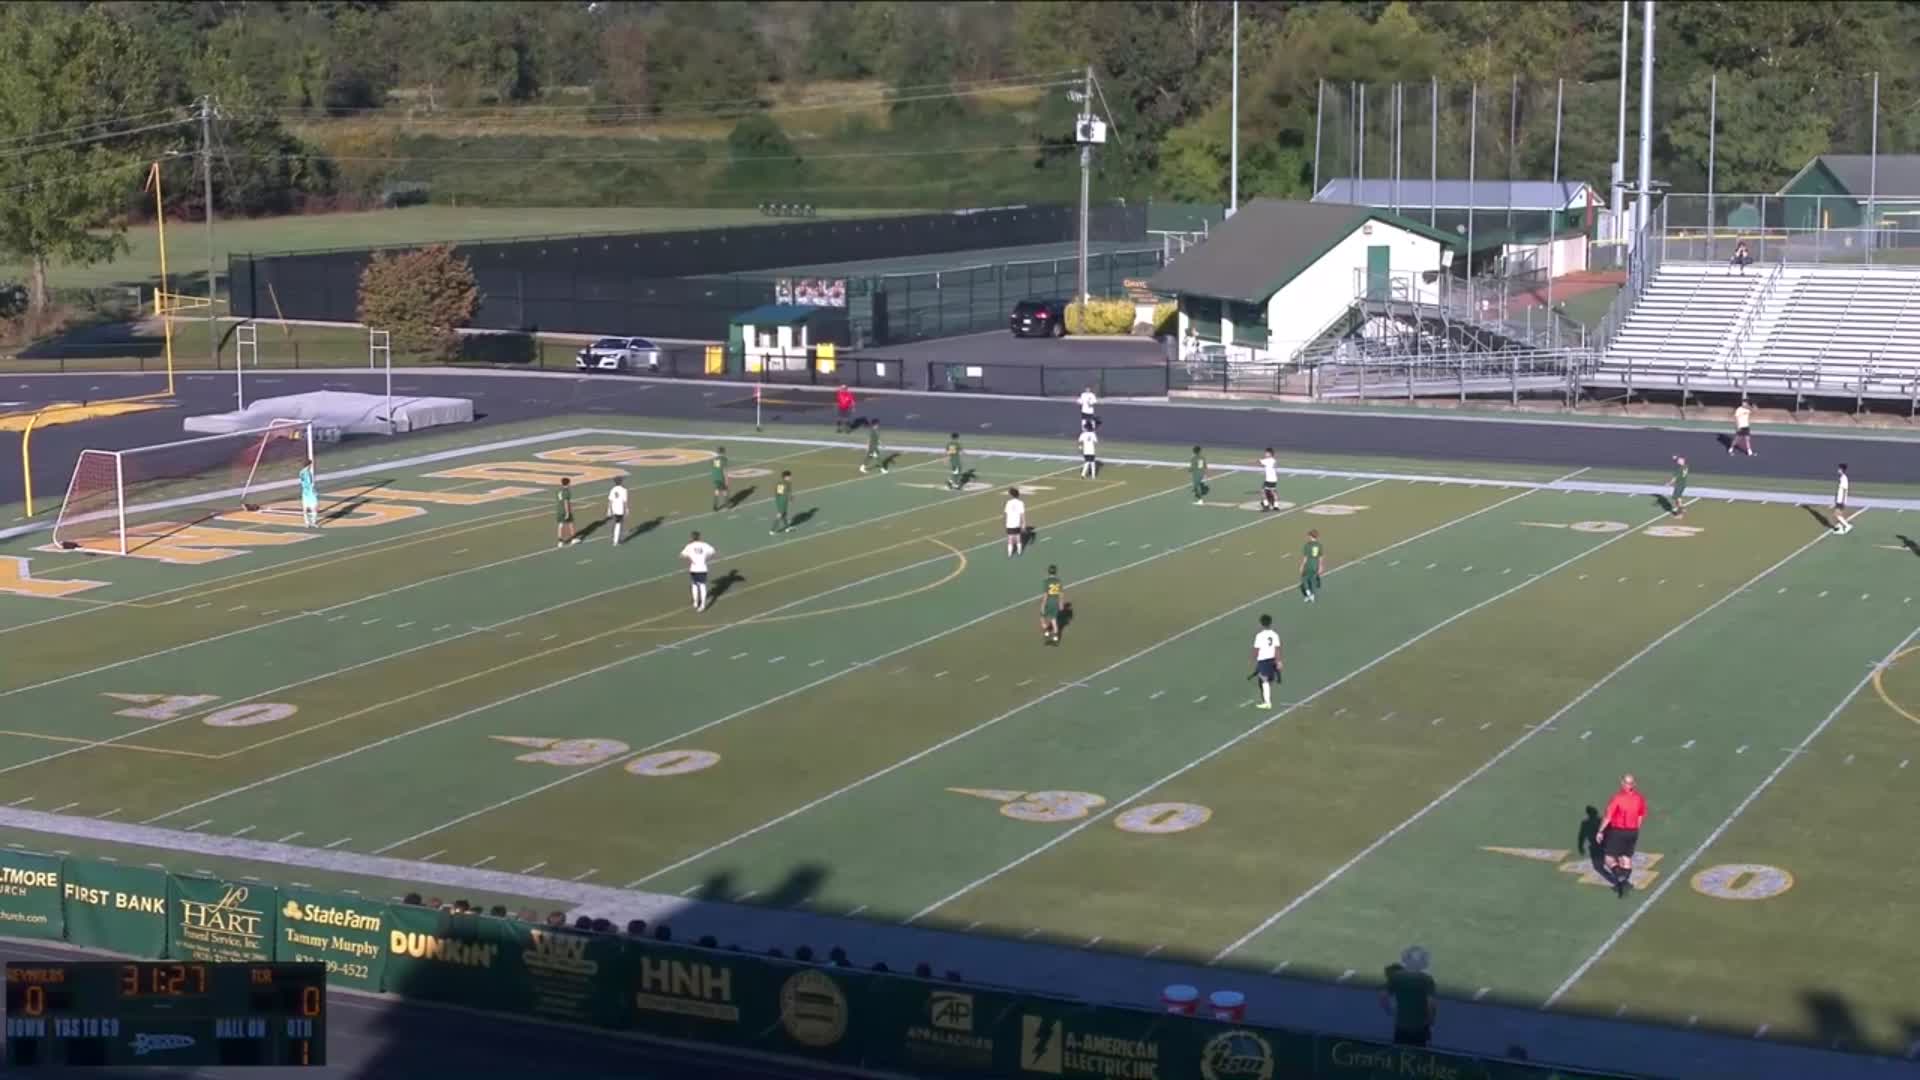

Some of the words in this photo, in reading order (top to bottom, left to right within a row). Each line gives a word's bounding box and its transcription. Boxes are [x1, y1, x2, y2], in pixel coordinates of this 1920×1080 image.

[0, 867, 58, 887] TMORE
[64, 883, 111, 906] FIRST
[115, 892, 166, 915] BANK
[182, 902, 262, 935] HART
[284, 927, 328, 951] Tammy
[330, 935, 380, 960] Murphy
[390, 929, 497, 968] DUNKIN'
[639, 955, 732, 1002] HNH
